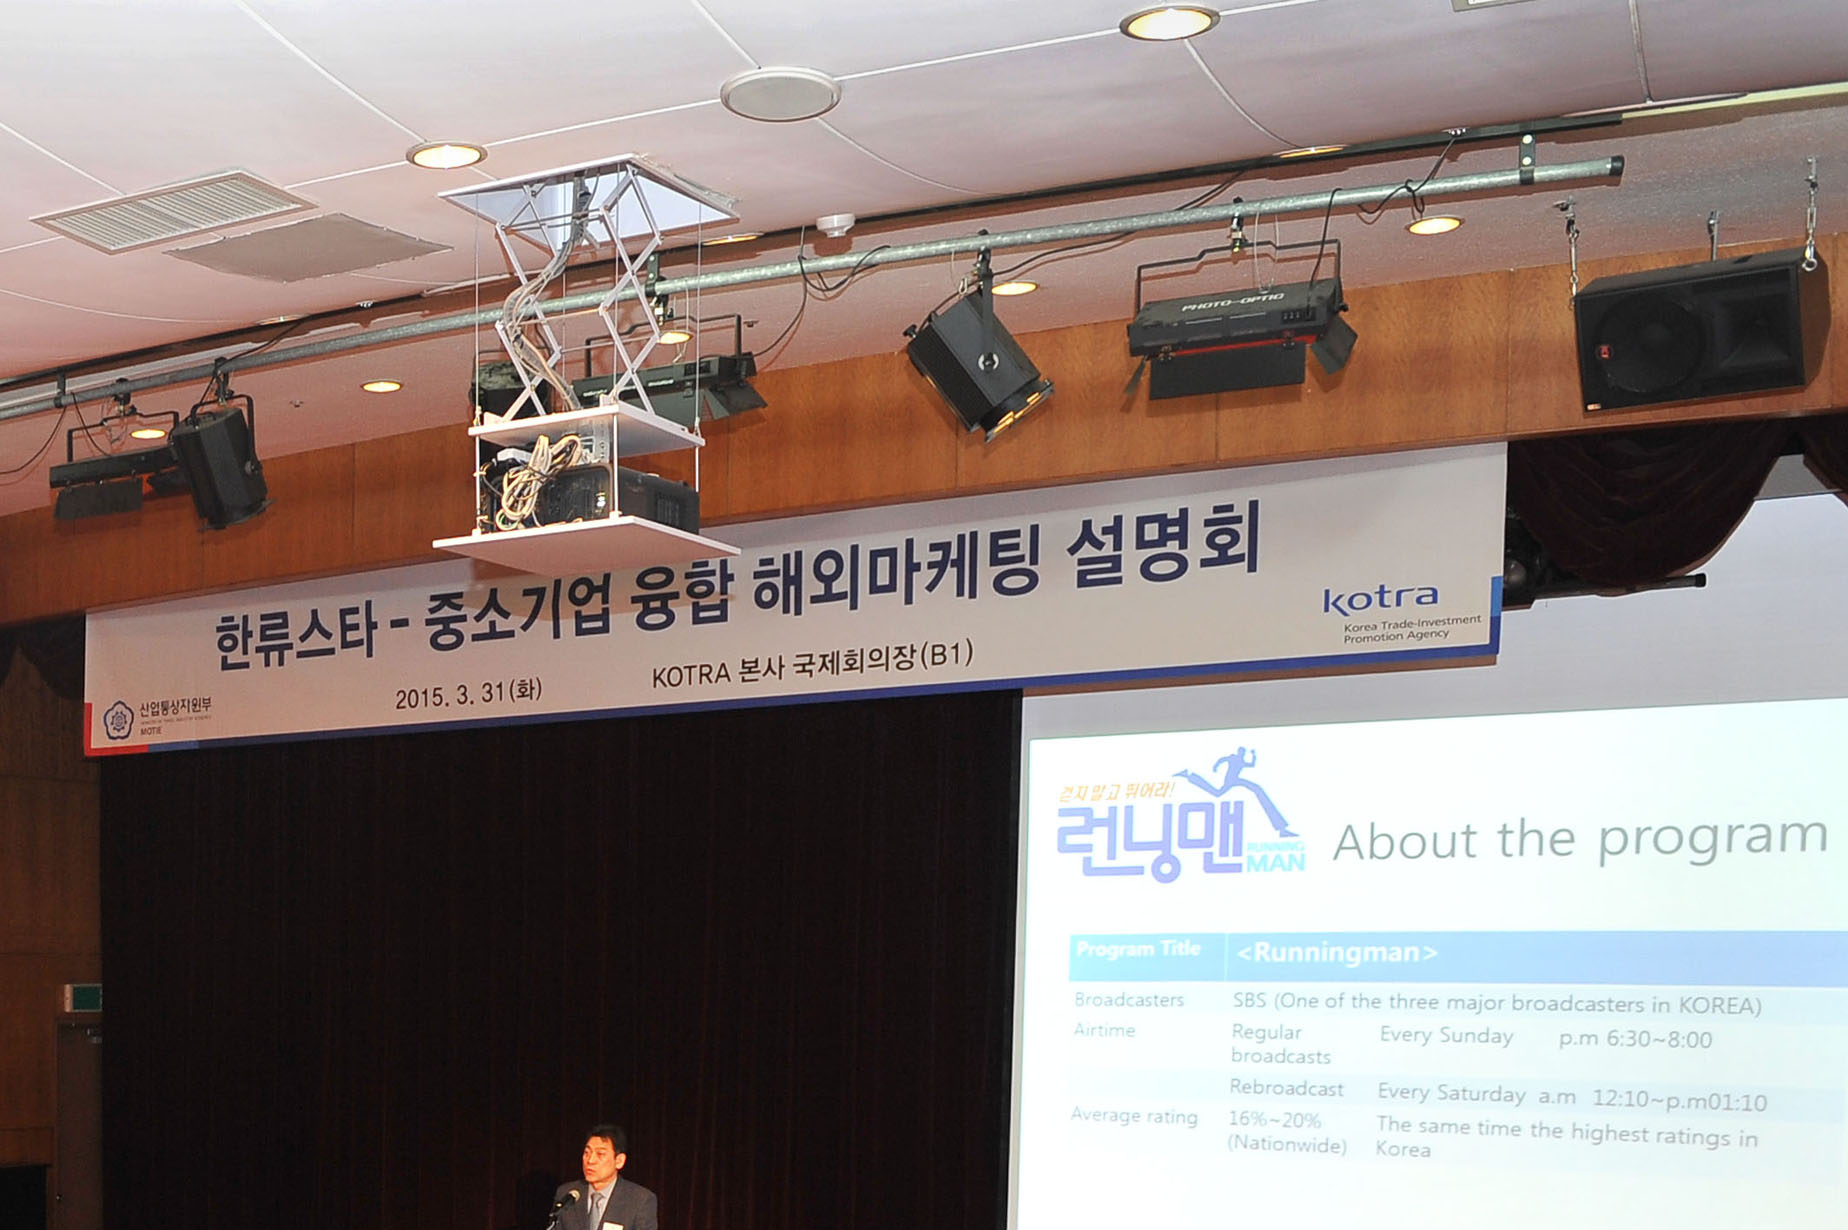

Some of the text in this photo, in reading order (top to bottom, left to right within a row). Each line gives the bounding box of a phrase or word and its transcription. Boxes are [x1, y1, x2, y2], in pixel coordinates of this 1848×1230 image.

[216, 600, 378, 672] 한류스타
[426, 573, 610, 651] 중소기업
[630, 558, 735, 630] 융합
[754, 523, 1040, 617] 해외마케팅
[1067, 499, 1260, 589] 설명회
[1323, 584, 1438, 617] kotra
[1344, 614, 1482, 633] Korea Trade-Investment
[1344, 629, 1450, 644] Promotion Agency
[652, 635, 974, 690] KOTRA 본사 국제회의장(B1)
[395, 677, 543, 711] 2015. 3. 31(화)
[1057, 800, 1244, 884] 런닝맨
[1332, 818, 1828, 867] About the program
[1247, 853, 1307, 872] MAN
[1076, 939, 1202, 961] Program Title
[1237, 940, 1438, 969] <Runningman>
[1075, 992, 1185, 1008] Broadcasters
[1233, 992, 1763, 1017] SBS (One of the three major broadcasters in KOREA)
[1074, 1023, 1136, 1038] Airtime
[1233, 1024, 1303, 1042] Regular
[1380, 1026, 1514, 1047] Every Sunday
[1559, 1030, 1712, 1049] p.m 6:30~8:00
[1232, 1047, 1331, 1065] broadcasts
[1230, 1078, 1344, 1097] Rebroadcast
[1378, 1083, 1768, 1113] Every Saturday a.m 12:10~p.m01:10
[1071, 1106, 1199, 1128] Average rating
[1229, 1111, 1322, 1129] 16%~20%
[1377, 1115, 1759, 1151] The same time the highest ratings in
[1227, 1134, 1348, 1157] (Nationwide)
[1376, 1140, 1432, 1158] Korea
